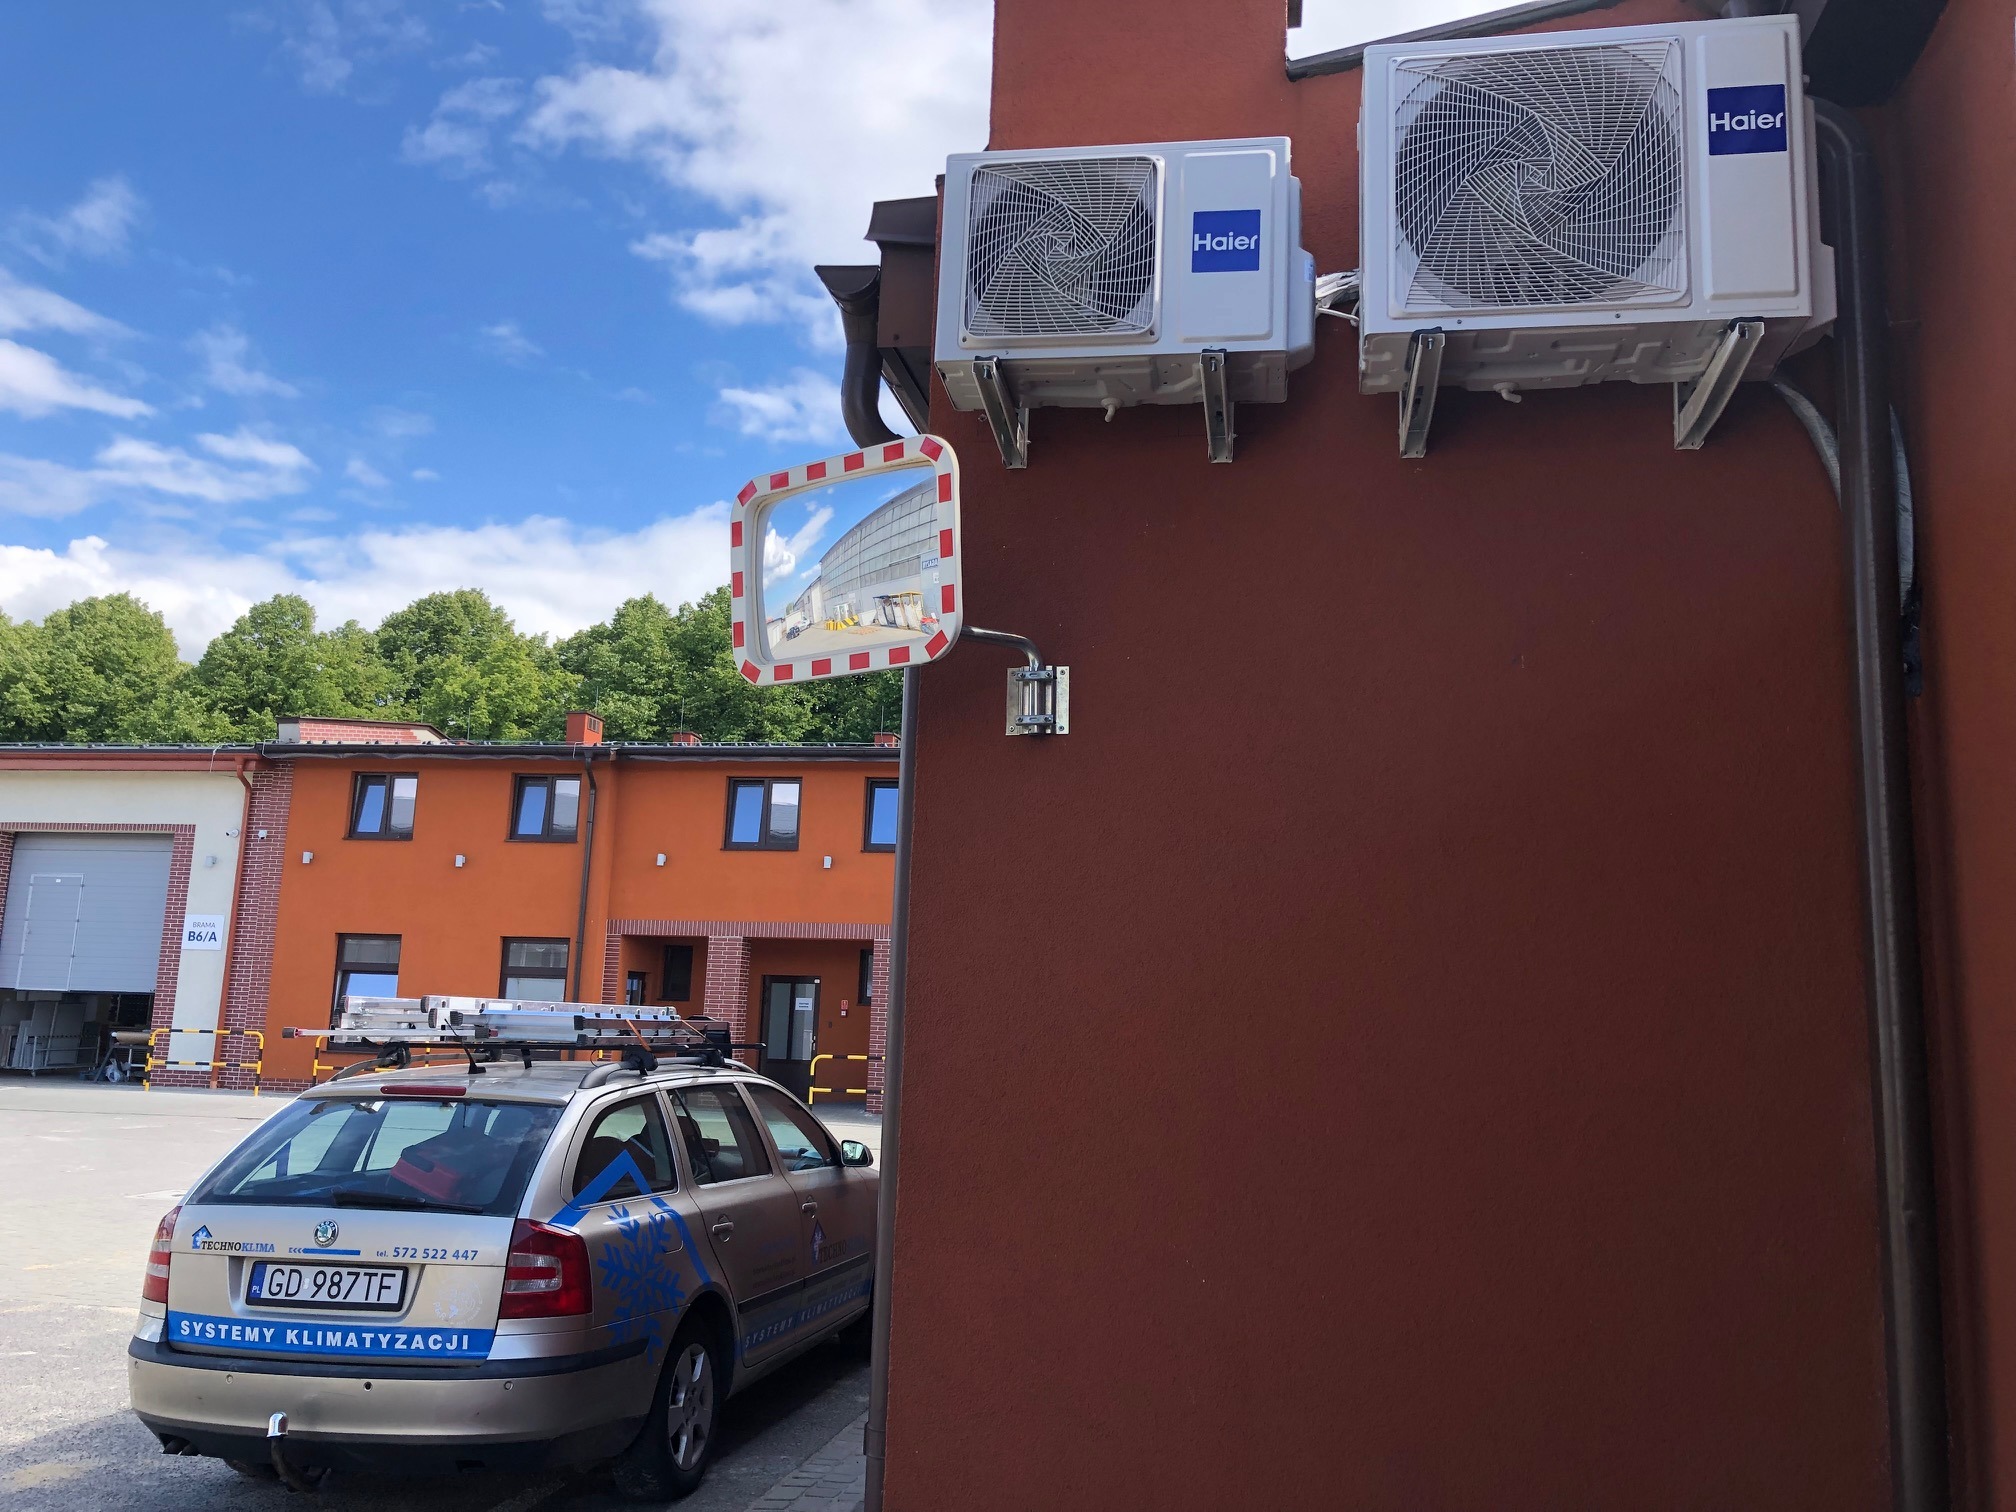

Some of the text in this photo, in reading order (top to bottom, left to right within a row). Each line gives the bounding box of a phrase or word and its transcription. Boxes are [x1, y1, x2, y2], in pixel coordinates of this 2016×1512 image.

[1710, 109, 1784, 132] Haier
[1193, 231, 1259, 251] Haier
[187, 930, 217, 942] B6/A
[201, 1240, 276, 1253] TECHNOKLIMA
[376, 1246, 478, 1261] tel. 572 522 447
[252, 1285, 261, 1294] PL
[268, 1267, 396, 1302] GD 987TF
[180, 1320, 469, 1351] SYSTEMY KLIMATYZACJI
[745, 1316, 793, 1348] SYSTEMY
